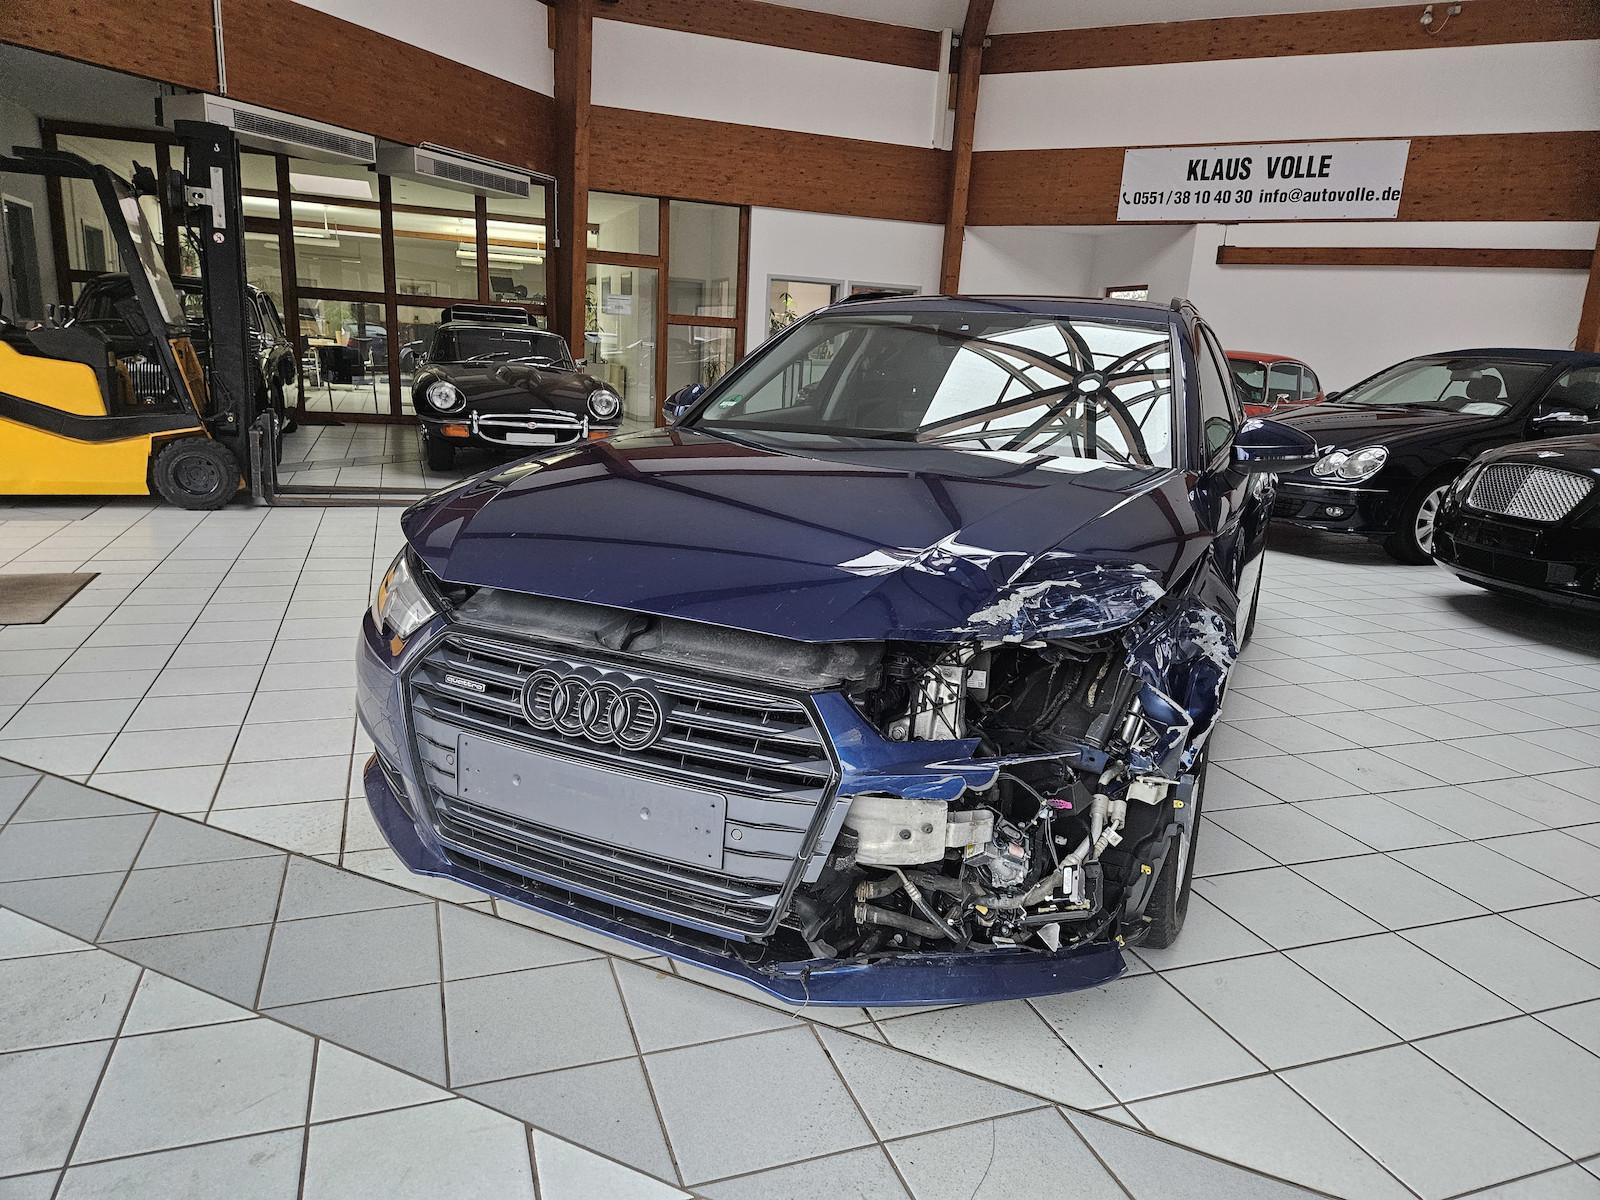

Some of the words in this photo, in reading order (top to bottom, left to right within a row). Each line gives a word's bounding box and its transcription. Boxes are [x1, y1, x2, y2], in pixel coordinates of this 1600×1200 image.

[1187, 157, 1253, 181] KLAUS
[1266, 155, 1333, 179] VOLLE
[1194, 190, 1211, 204] 10
[1213, 190, 1231, 204] 40
[1235, 189, 1253, 204] 30
[1259, 187, 1400, 203] info@autovolle.de
[446, 676, 483, 690] quattro
